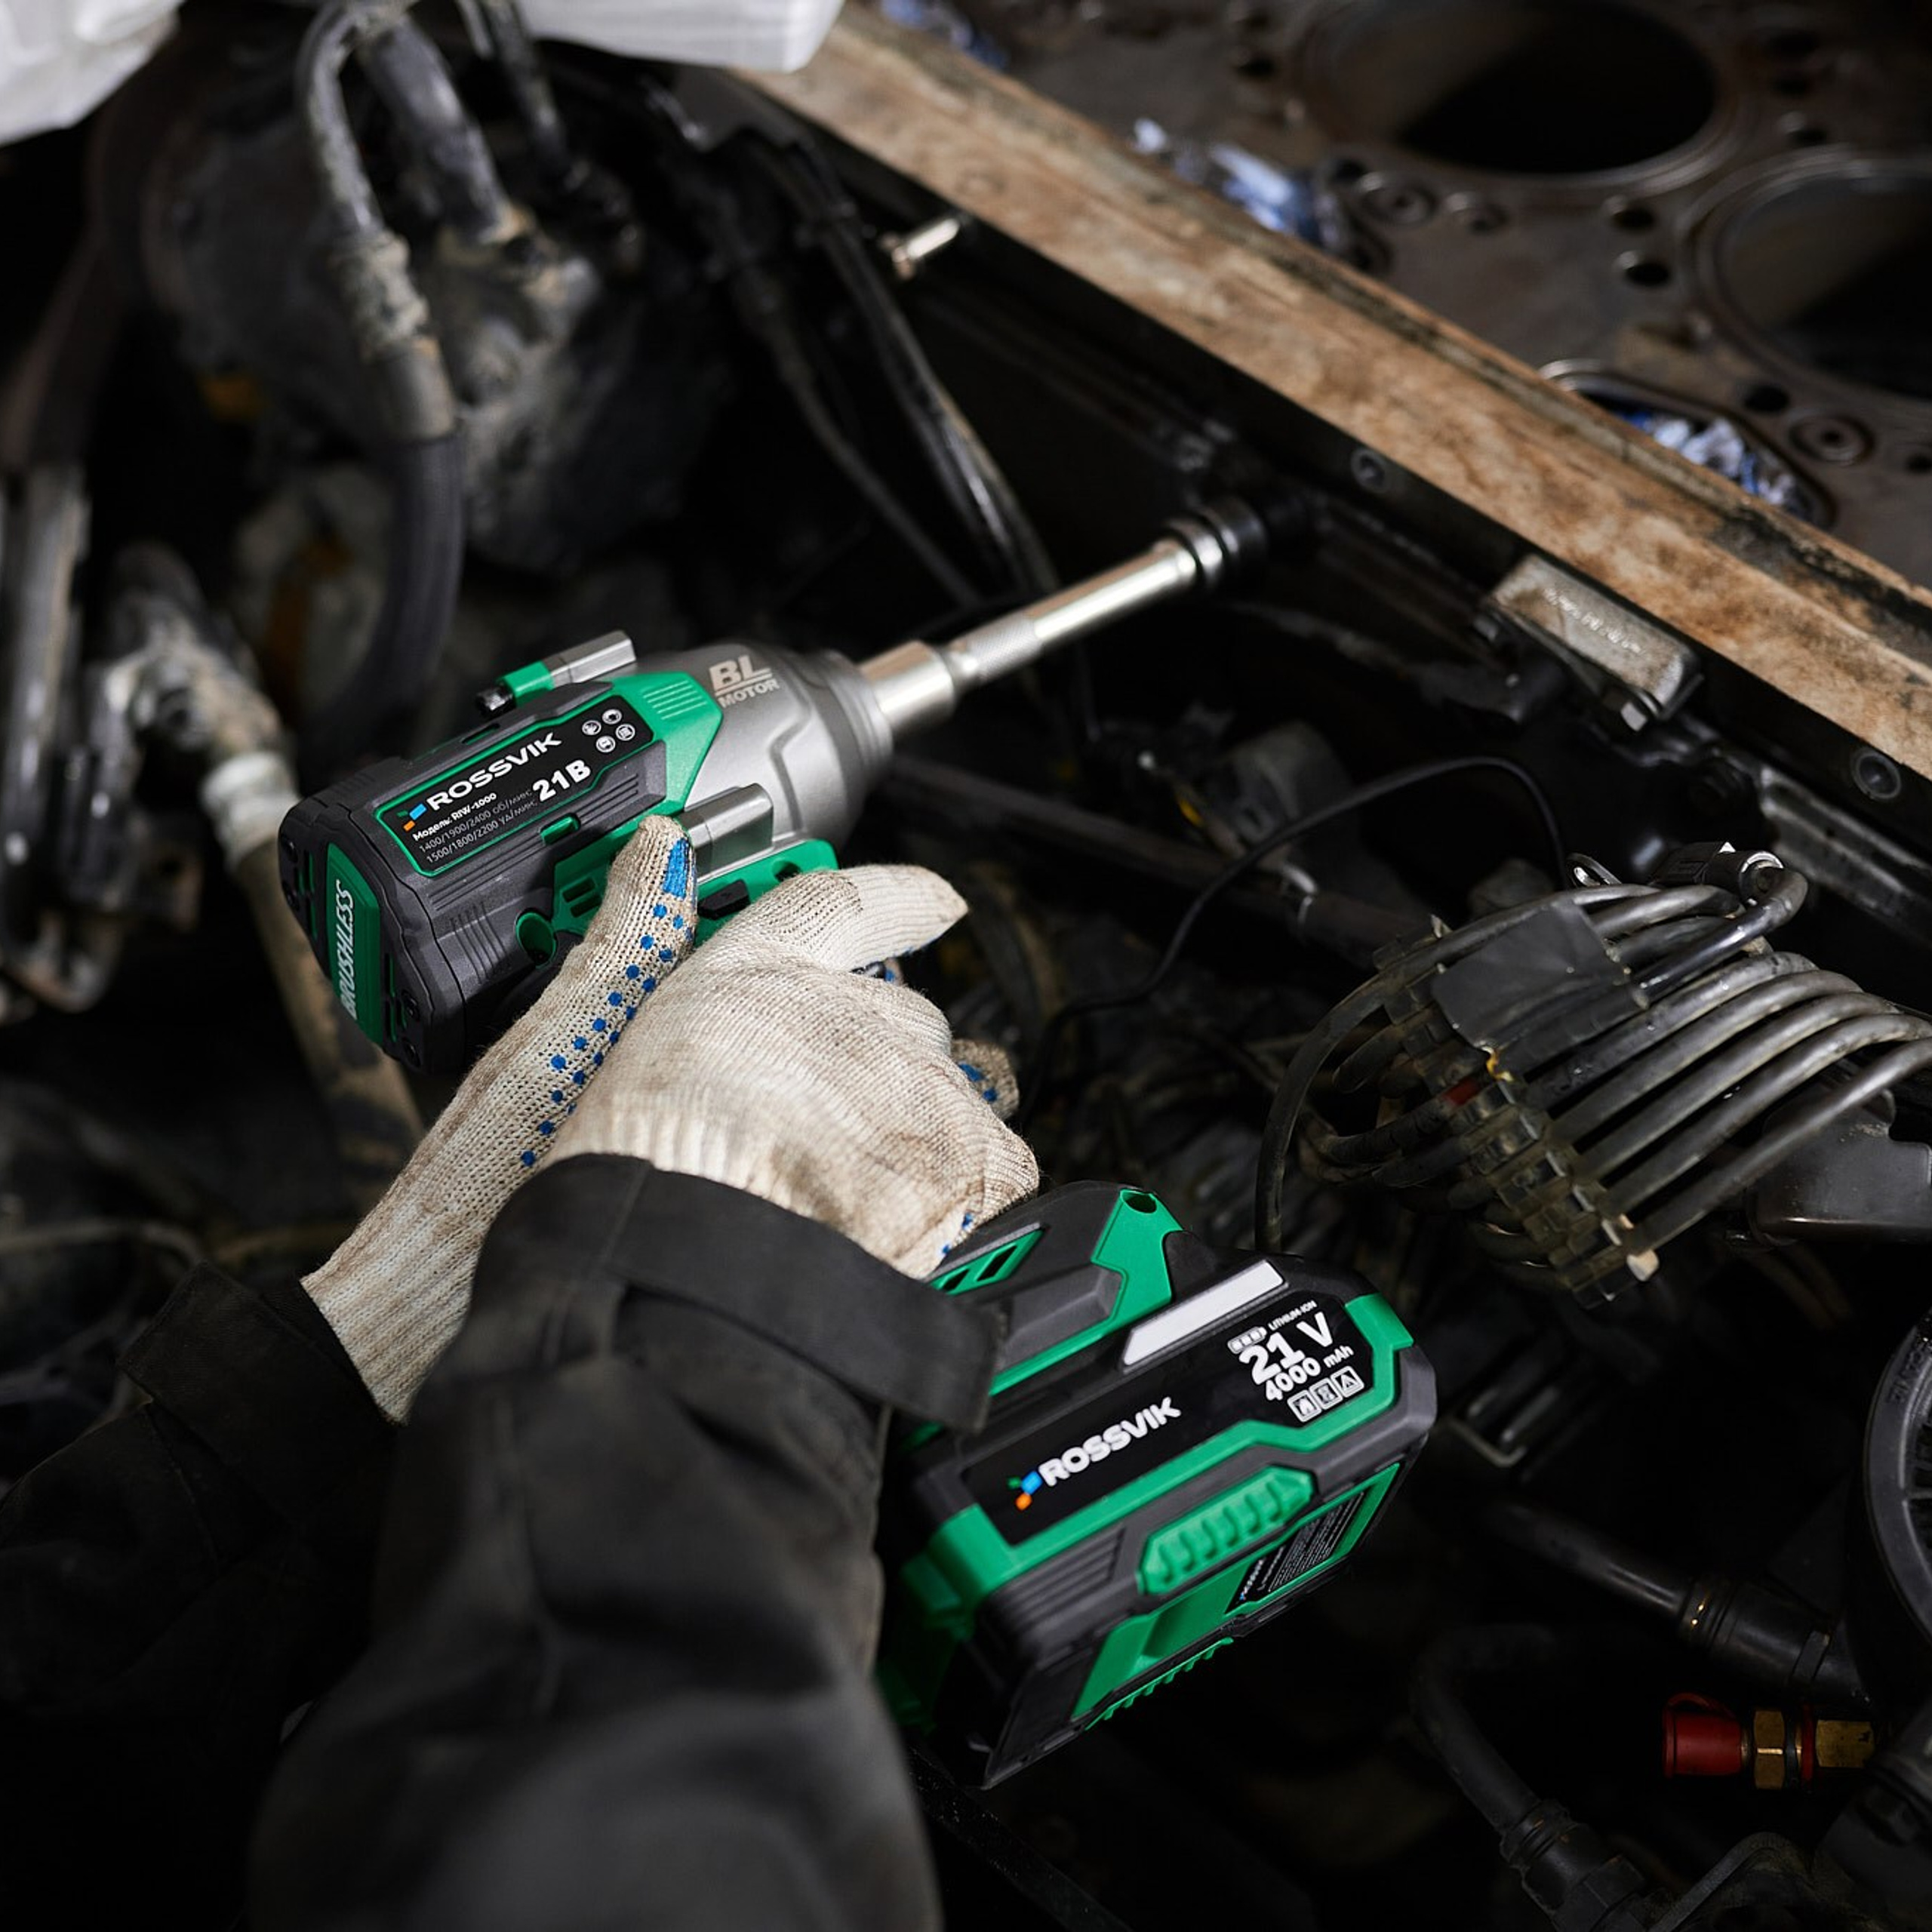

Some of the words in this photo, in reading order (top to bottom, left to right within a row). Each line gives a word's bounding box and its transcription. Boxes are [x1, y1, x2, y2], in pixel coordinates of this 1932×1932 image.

[709, 654, 771, 690] BL
[718, 678, 780, 708] MOTOR
[426, 732, 561, 811] ROSSVIK
[426, 820, 499, 863] 1500/1800/2200
[335, 878, 358, 1020] BRUSHLESS
[1238, 1332, 1306, 1385] 21
[1296, 1312, 1333, 1347] V
[1266, 1358, 1321, 1401] 4000
[1323, 1345, 1355, 1368] mAh
[1038, 1396, 1182, 1487] ROSSVIK
